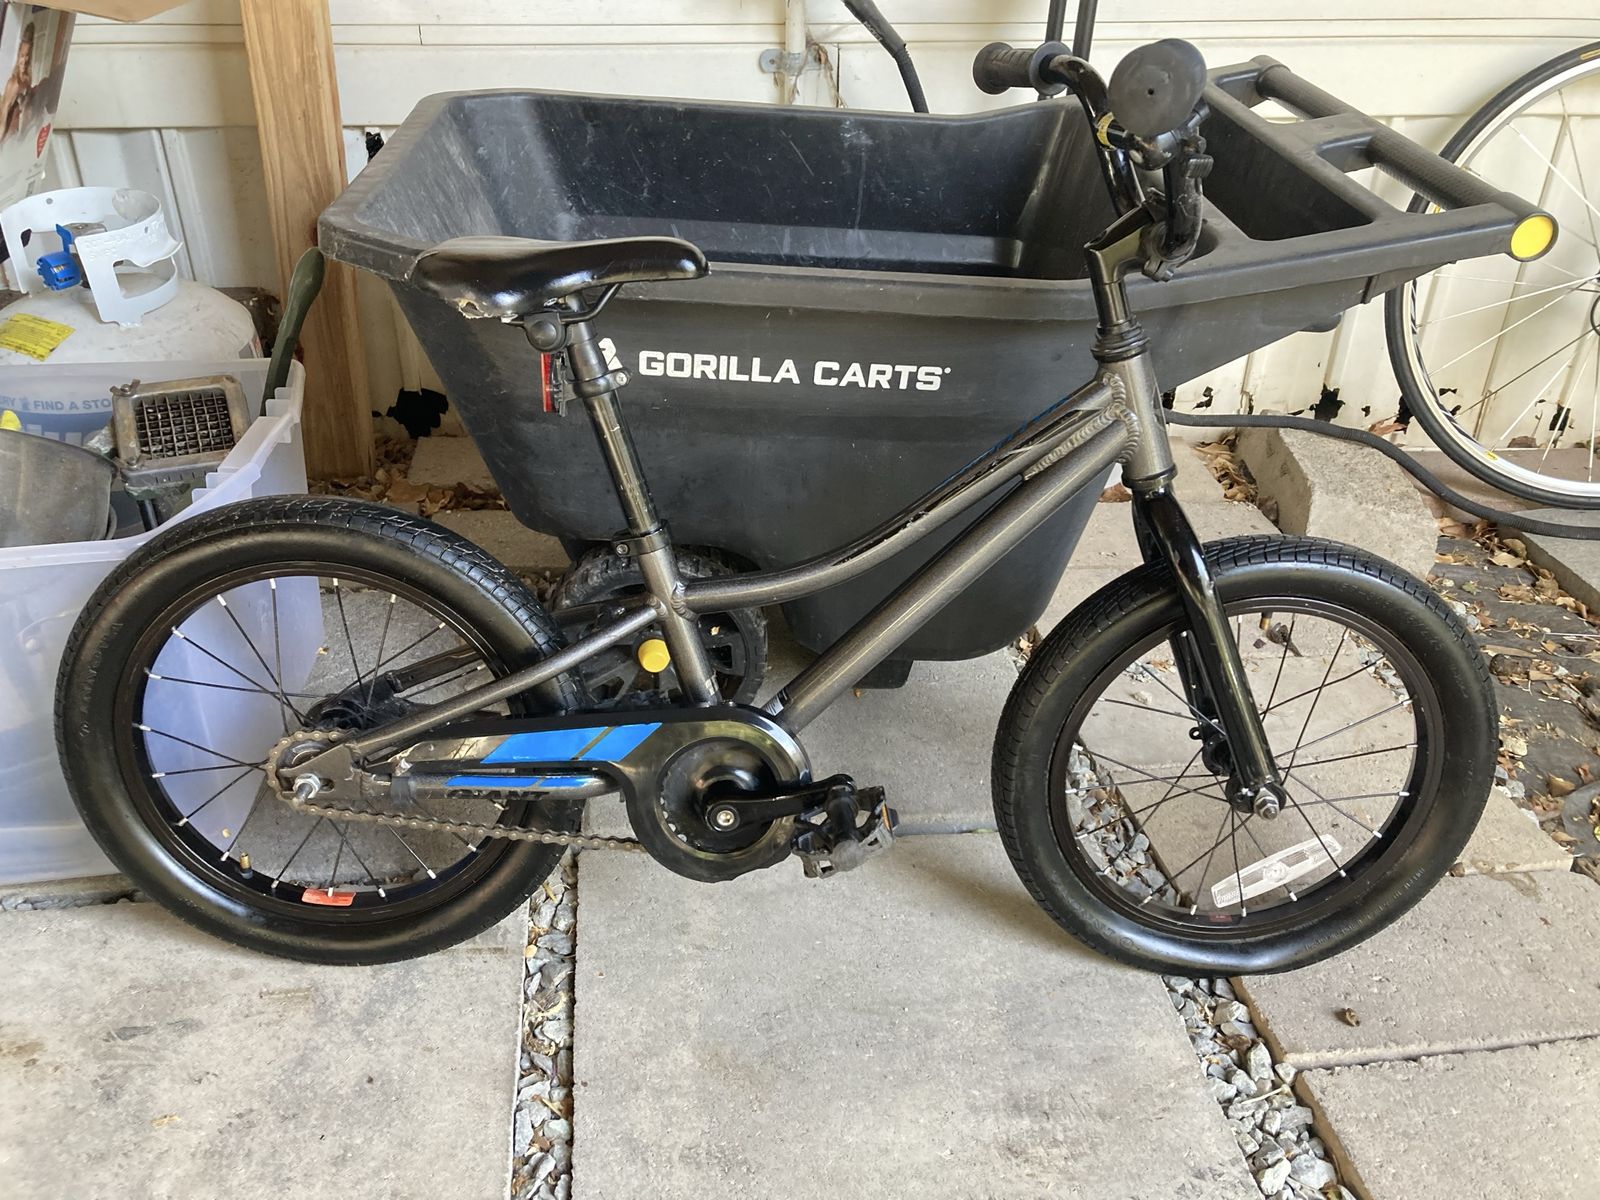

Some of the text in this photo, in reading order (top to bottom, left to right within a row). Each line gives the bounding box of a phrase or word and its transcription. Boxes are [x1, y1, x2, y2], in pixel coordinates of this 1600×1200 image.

[638, 350, 942, 391] GORILLA CARTS
[33, 400, 64, 411] FIND
[69, 401, 79, 411] A
[82, 398, 112, 410] STO
